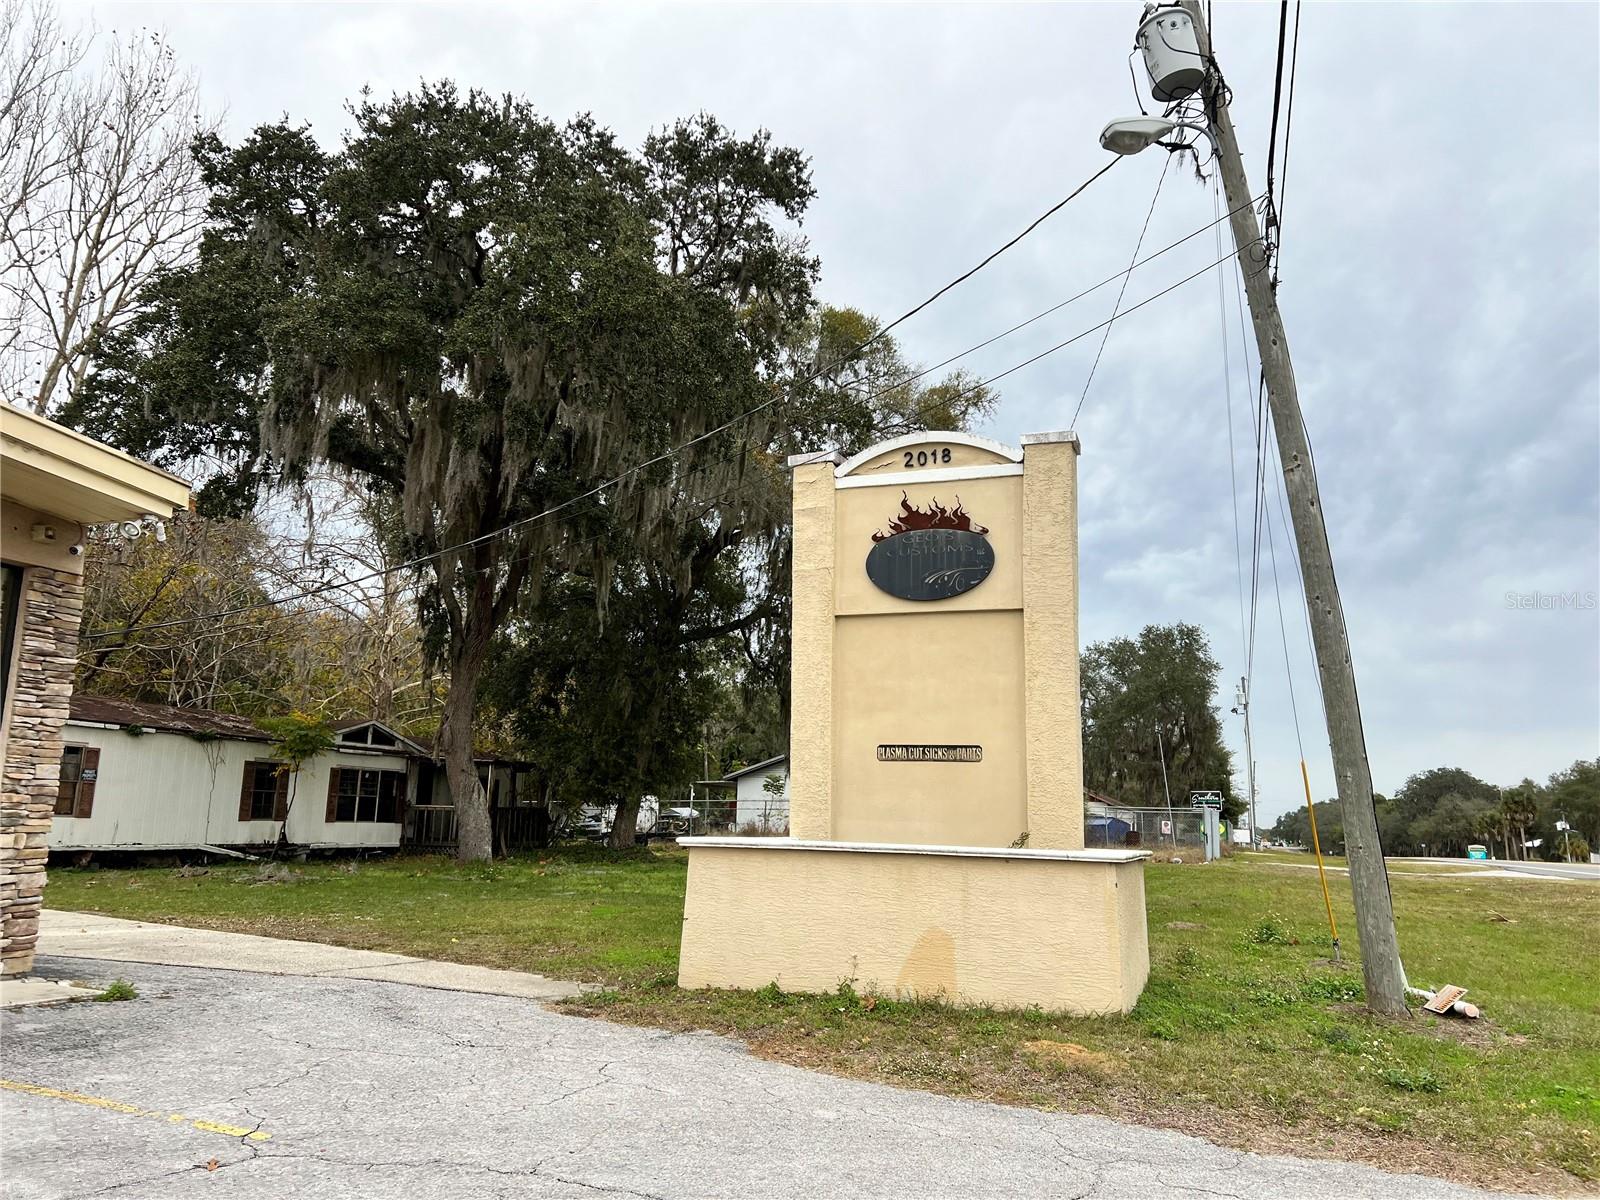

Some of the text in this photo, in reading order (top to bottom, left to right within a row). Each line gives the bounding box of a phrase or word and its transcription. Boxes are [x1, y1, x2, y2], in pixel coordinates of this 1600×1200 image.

[904, 448, 951, 467] 2018
[877, 746, 982, 760] PLASMA CUT SIGNS & PARTS
